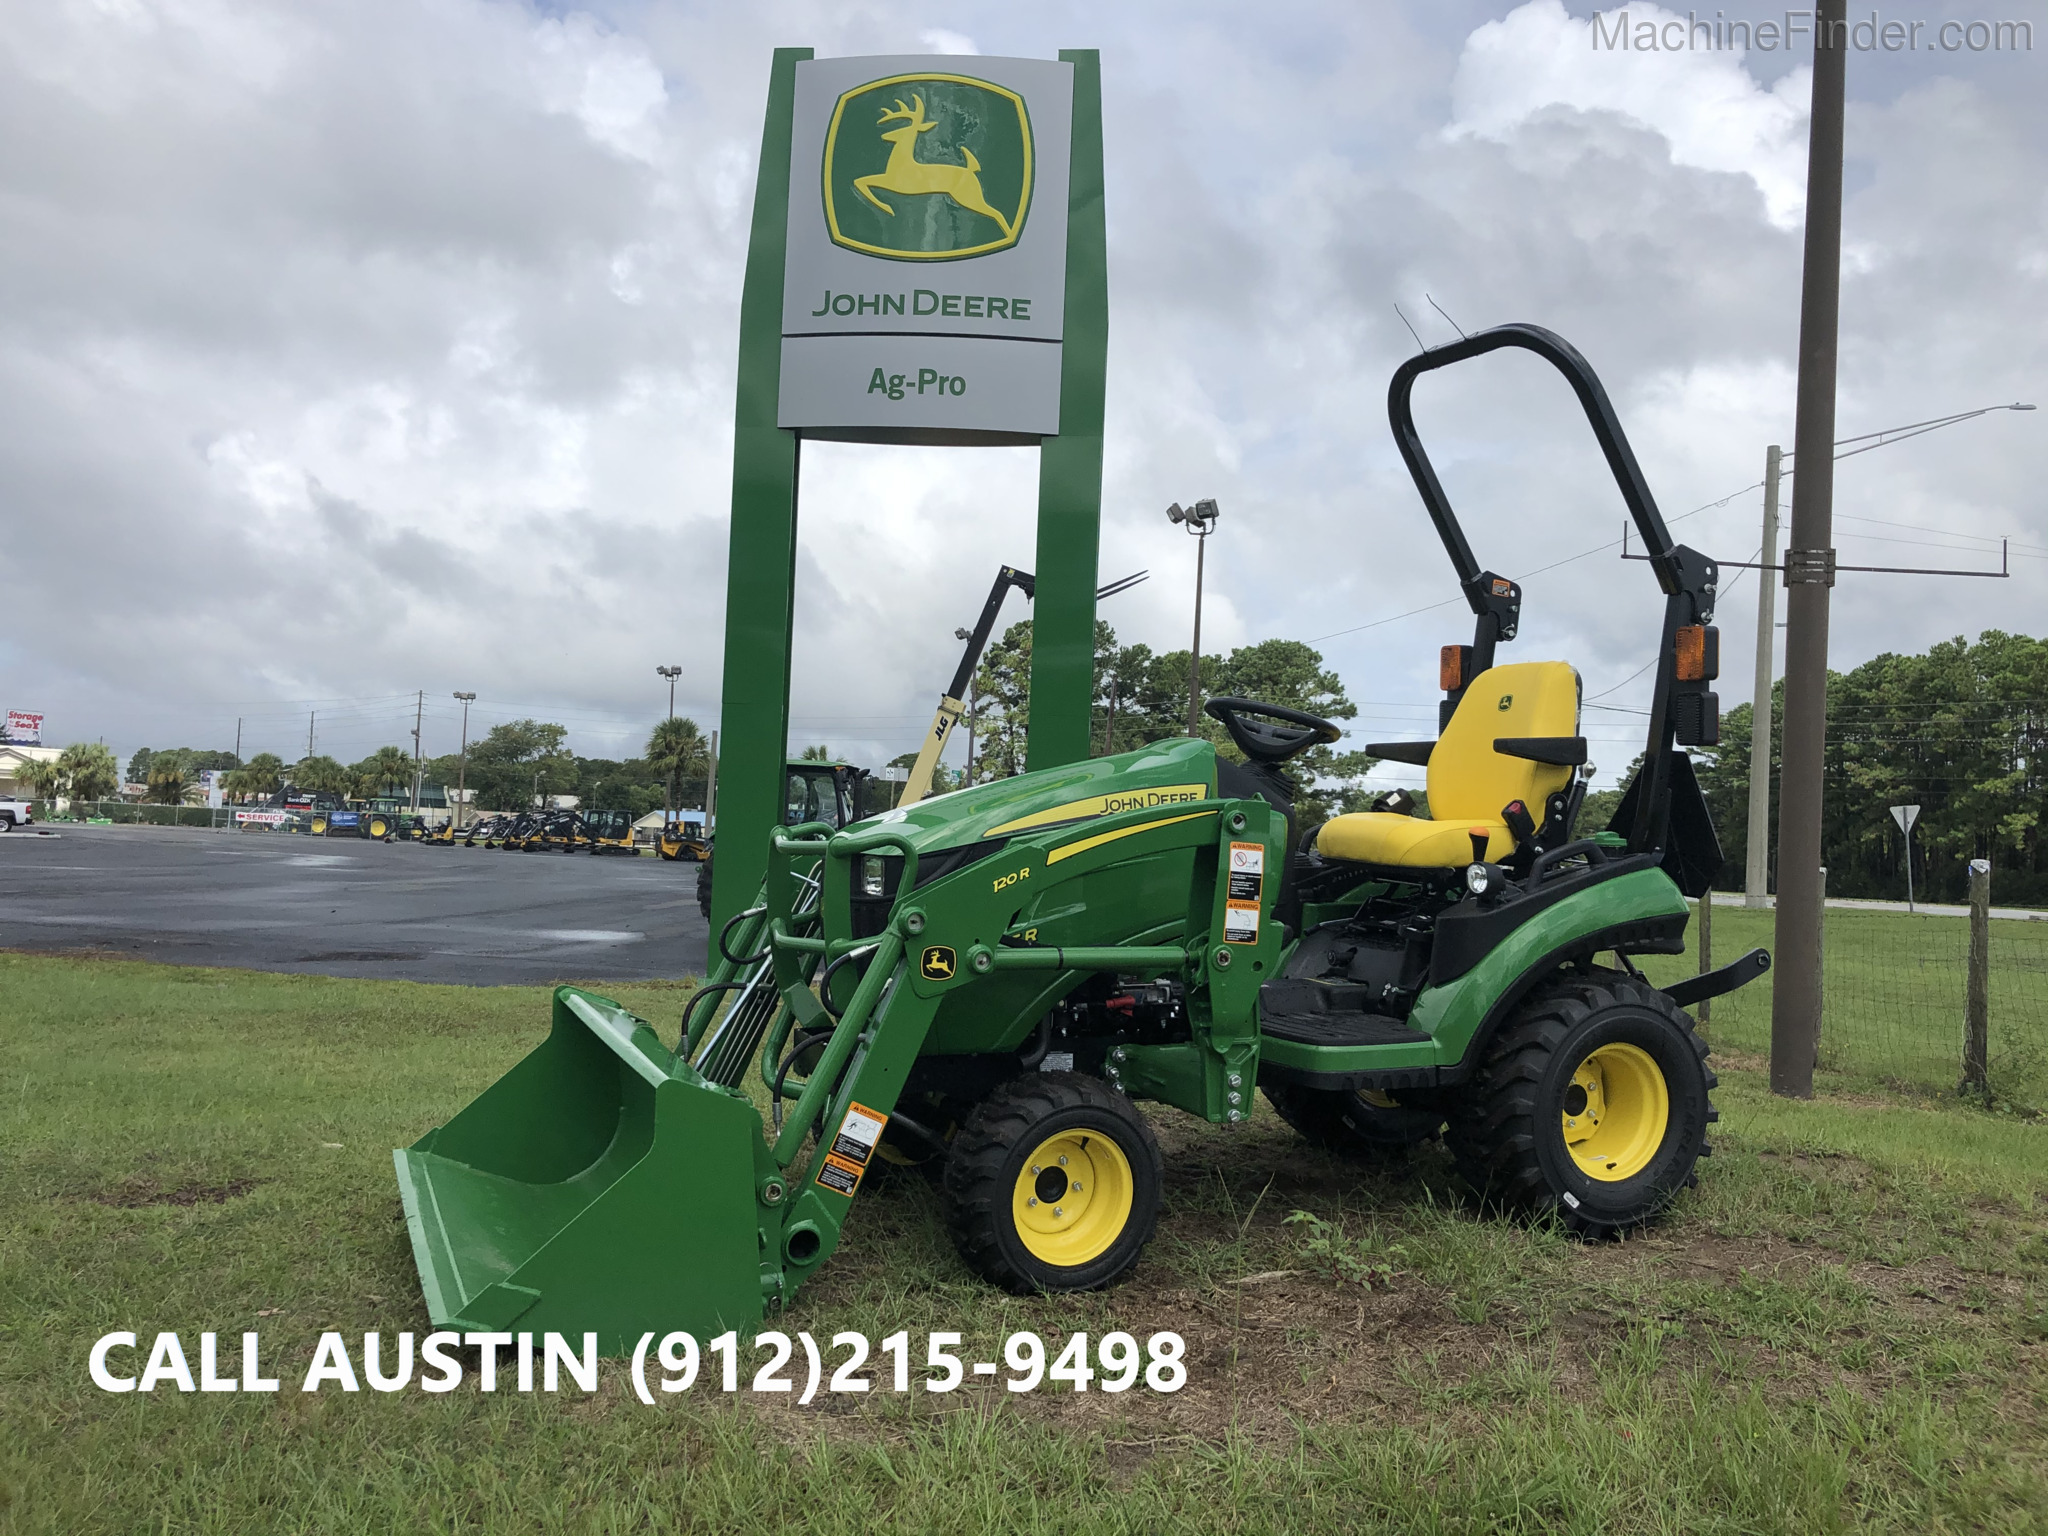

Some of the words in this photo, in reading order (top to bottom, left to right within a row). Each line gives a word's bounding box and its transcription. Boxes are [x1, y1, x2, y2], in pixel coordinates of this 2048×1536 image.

[812, 290, 905, 317] JOHN
[913, 289, 1032, 321] DEERE
[867, 367, 967, 400] Ag-Pro
[935, 715, 949, 742] JLG
[1100, 797, 1144, 814] JOHN
[246, 813, 284, 821] SERVICE
[1236, 843, 1263, 851] WARNING
[992, 872, 1018, 893] 120
[859, 1107, 883, 1121] WARNING
[835, 1160, 859, 1174] WARNING
